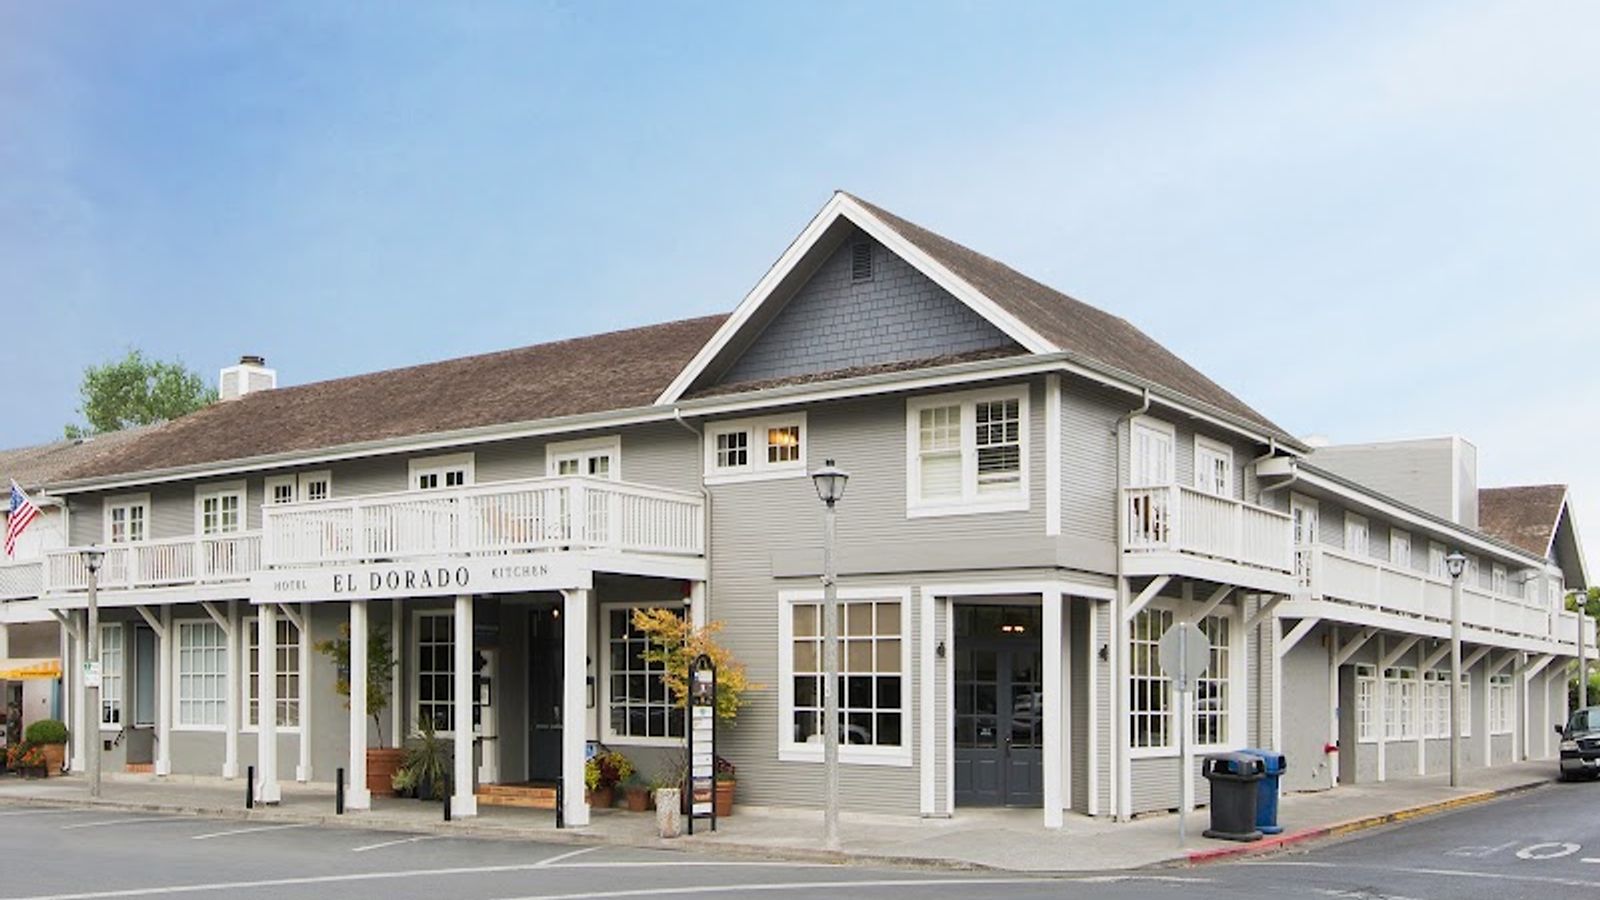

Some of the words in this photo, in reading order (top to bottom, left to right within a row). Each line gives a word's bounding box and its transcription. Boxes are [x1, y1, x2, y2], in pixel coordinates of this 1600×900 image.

[273, 580, 307, 591] HOTEL
[333, 574, 357, 592] EL
[369, 566, 470, 592] DORADO
[491, 565, 548, 578] KITCHEN
